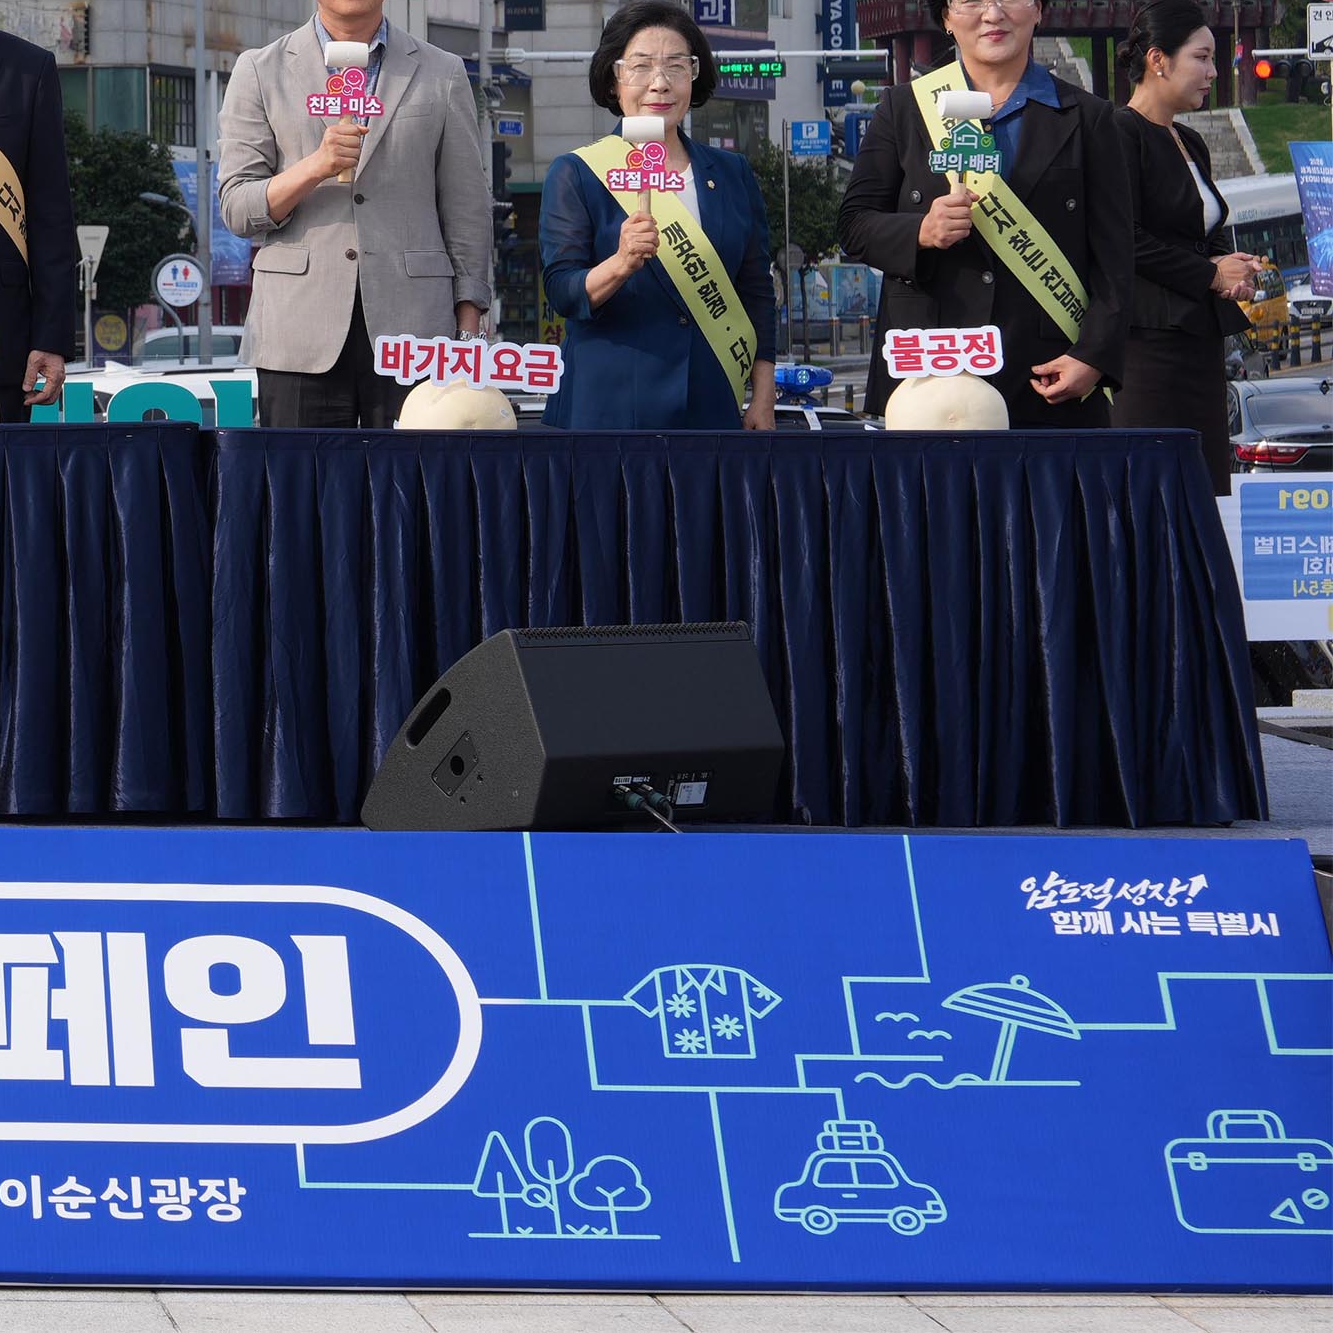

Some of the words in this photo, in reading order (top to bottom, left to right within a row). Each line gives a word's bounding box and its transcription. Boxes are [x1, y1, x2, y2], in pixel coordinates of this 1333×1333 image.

[307, 93, 383, 117] 친절·미소
[608, 167, 684, 192] 친절·미소
[932, 153, 1000, 173] 편의·배려
[977, 191, 1018, 235] 다시
[1007, 229, 1049, 272] 찾는
[660, 220, 710, 283] 깨끗한
[696, 279, 728, 320] 환경
[380, 340, 484, 383] 바가지
[490, 345, 561, 389] 요금
[889, 329, 998, 373] 불공정
[1020, 870, 1117, 910] 압도적
[1049, 910, 1115, 936] 함께
[1119, 911, 1182, 936] 사는
[1186, 911, 1282, 938] 특별시
